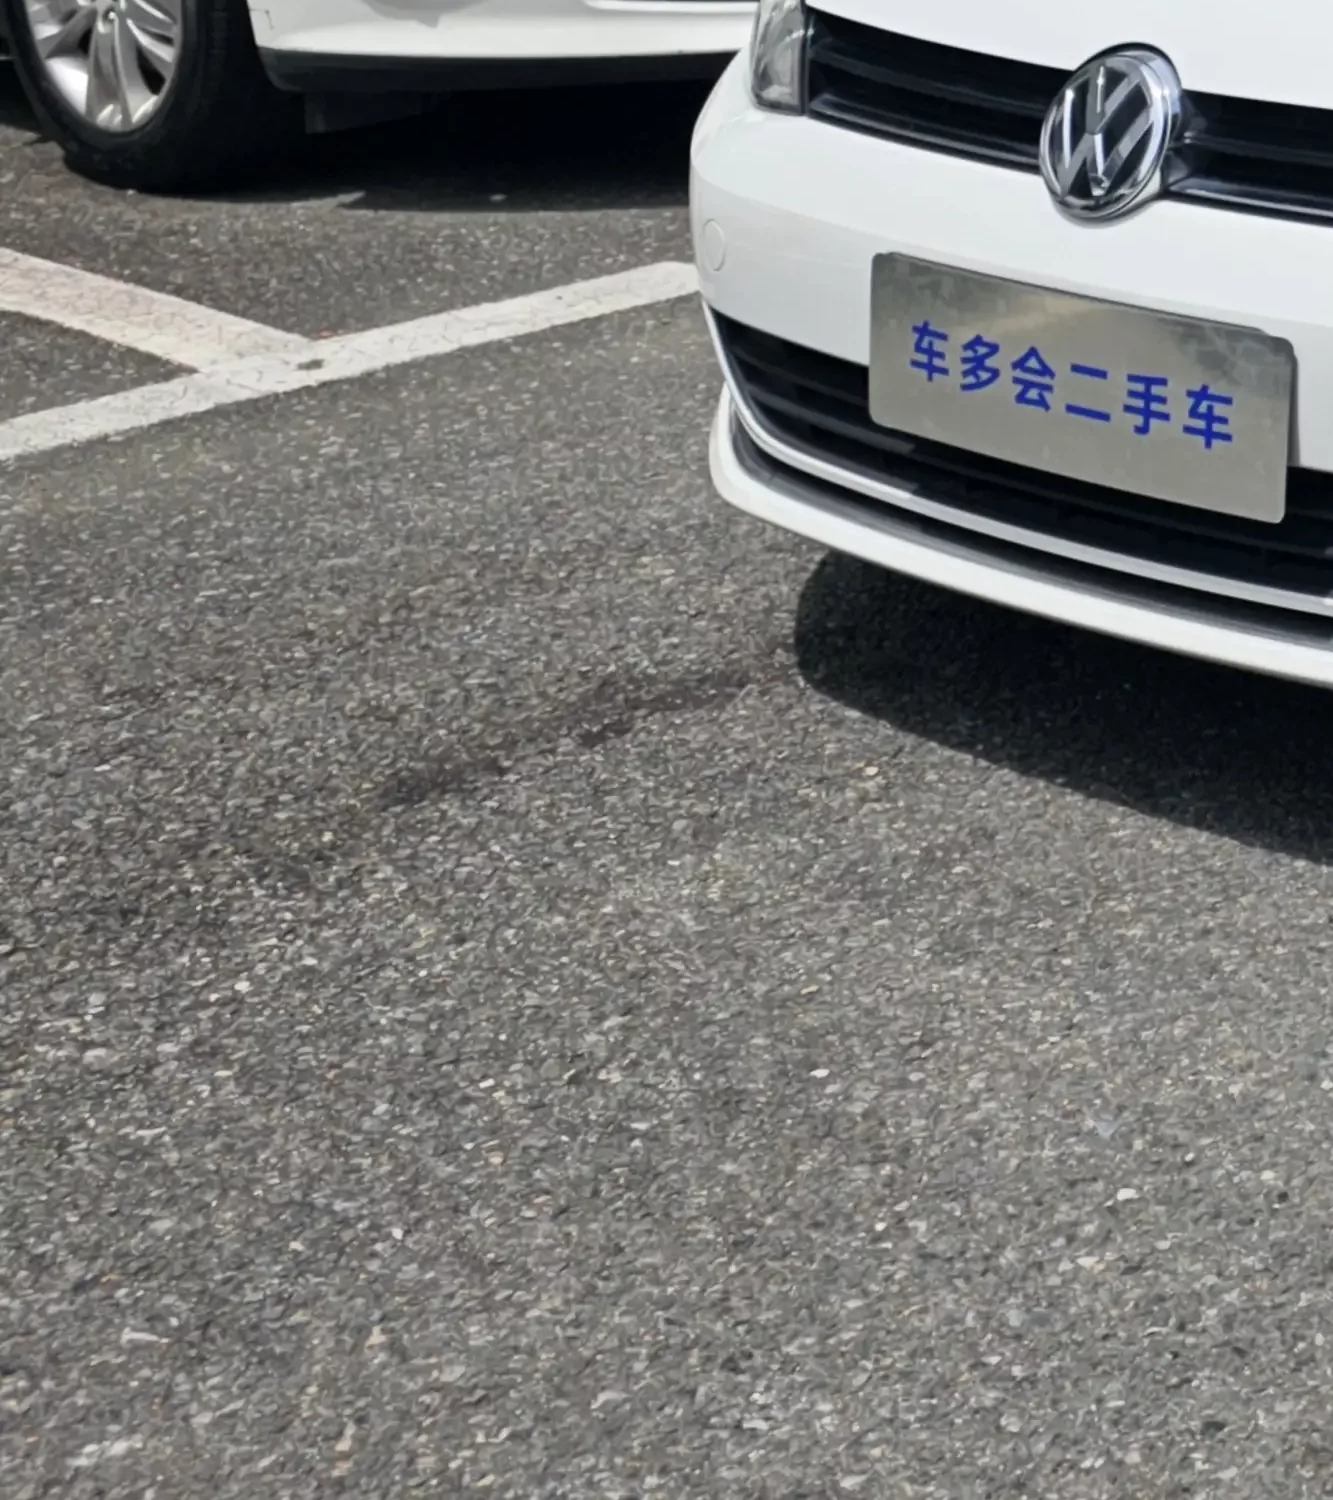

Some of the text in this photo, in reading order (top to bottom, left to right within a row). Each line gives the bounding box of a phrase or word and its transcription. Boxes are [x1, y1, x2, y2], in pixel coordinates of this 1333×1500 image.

[909, 320, 1234, 450] 车多会二手车
